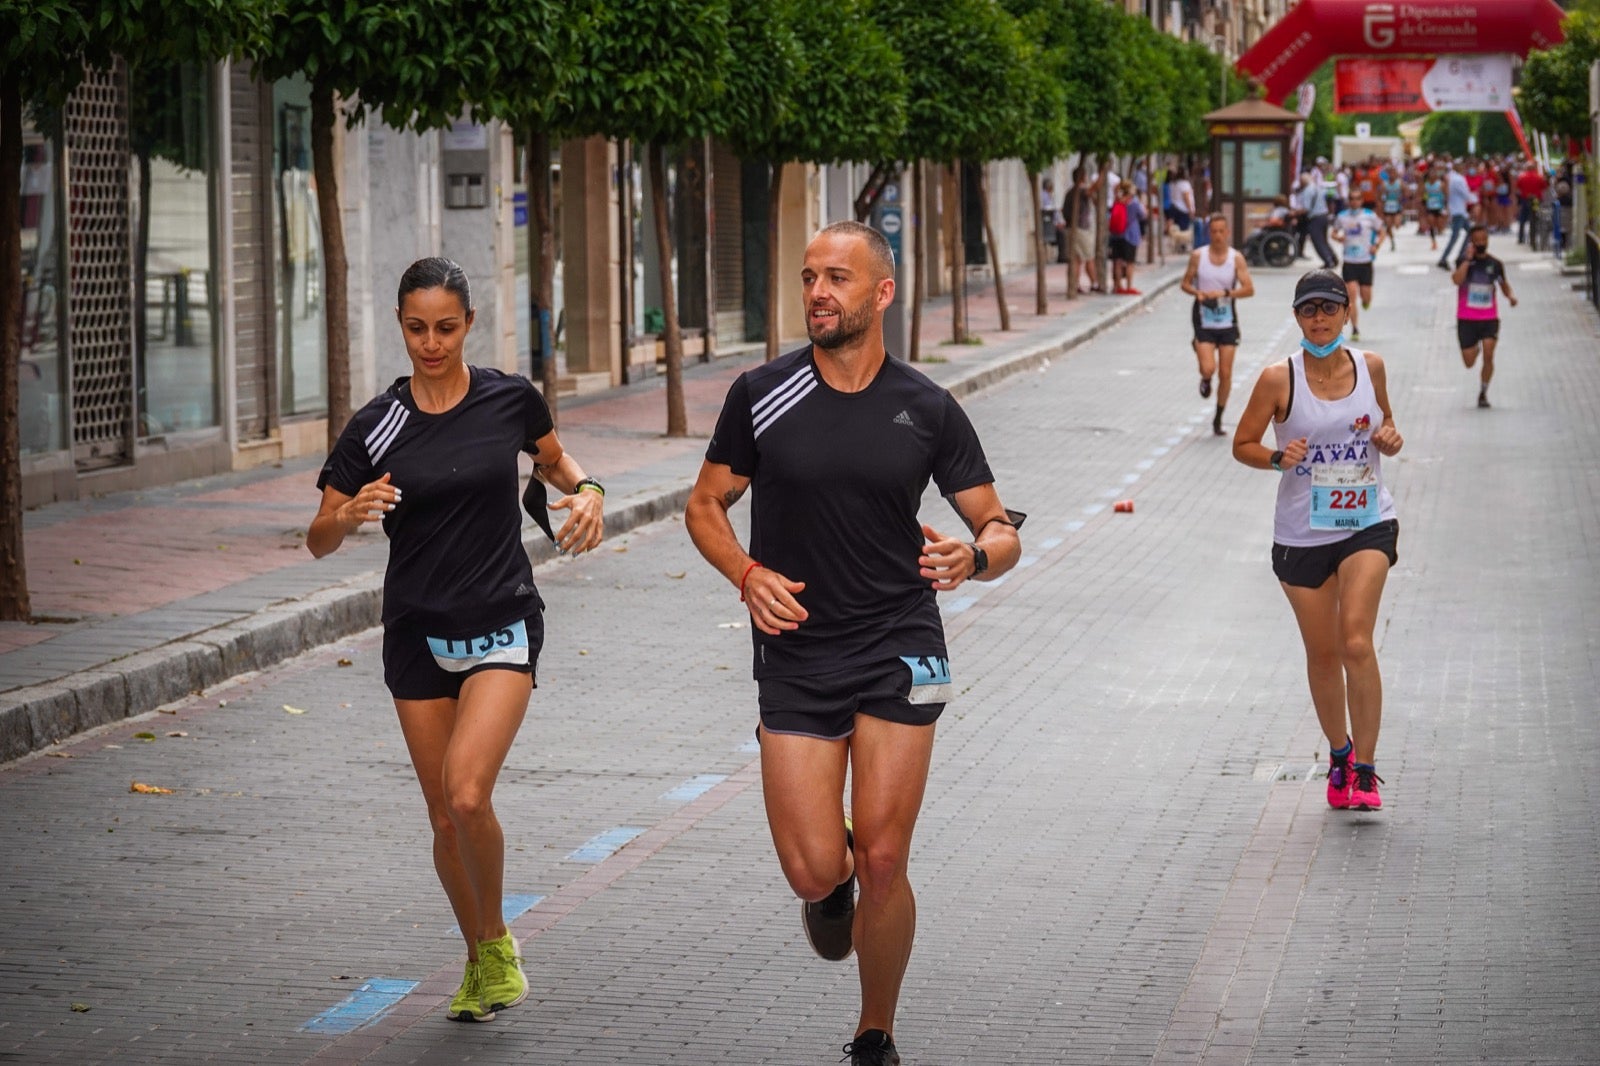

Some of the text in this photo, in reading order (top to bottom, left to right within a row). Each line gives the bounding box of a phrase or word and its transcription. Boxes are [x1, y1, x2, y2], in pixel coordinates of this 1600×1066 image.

[1400, 4, 1477, 20] Diputación
[1417, 20, 1477, 35] Granada
[1329, 489, 1367, 509] 224
